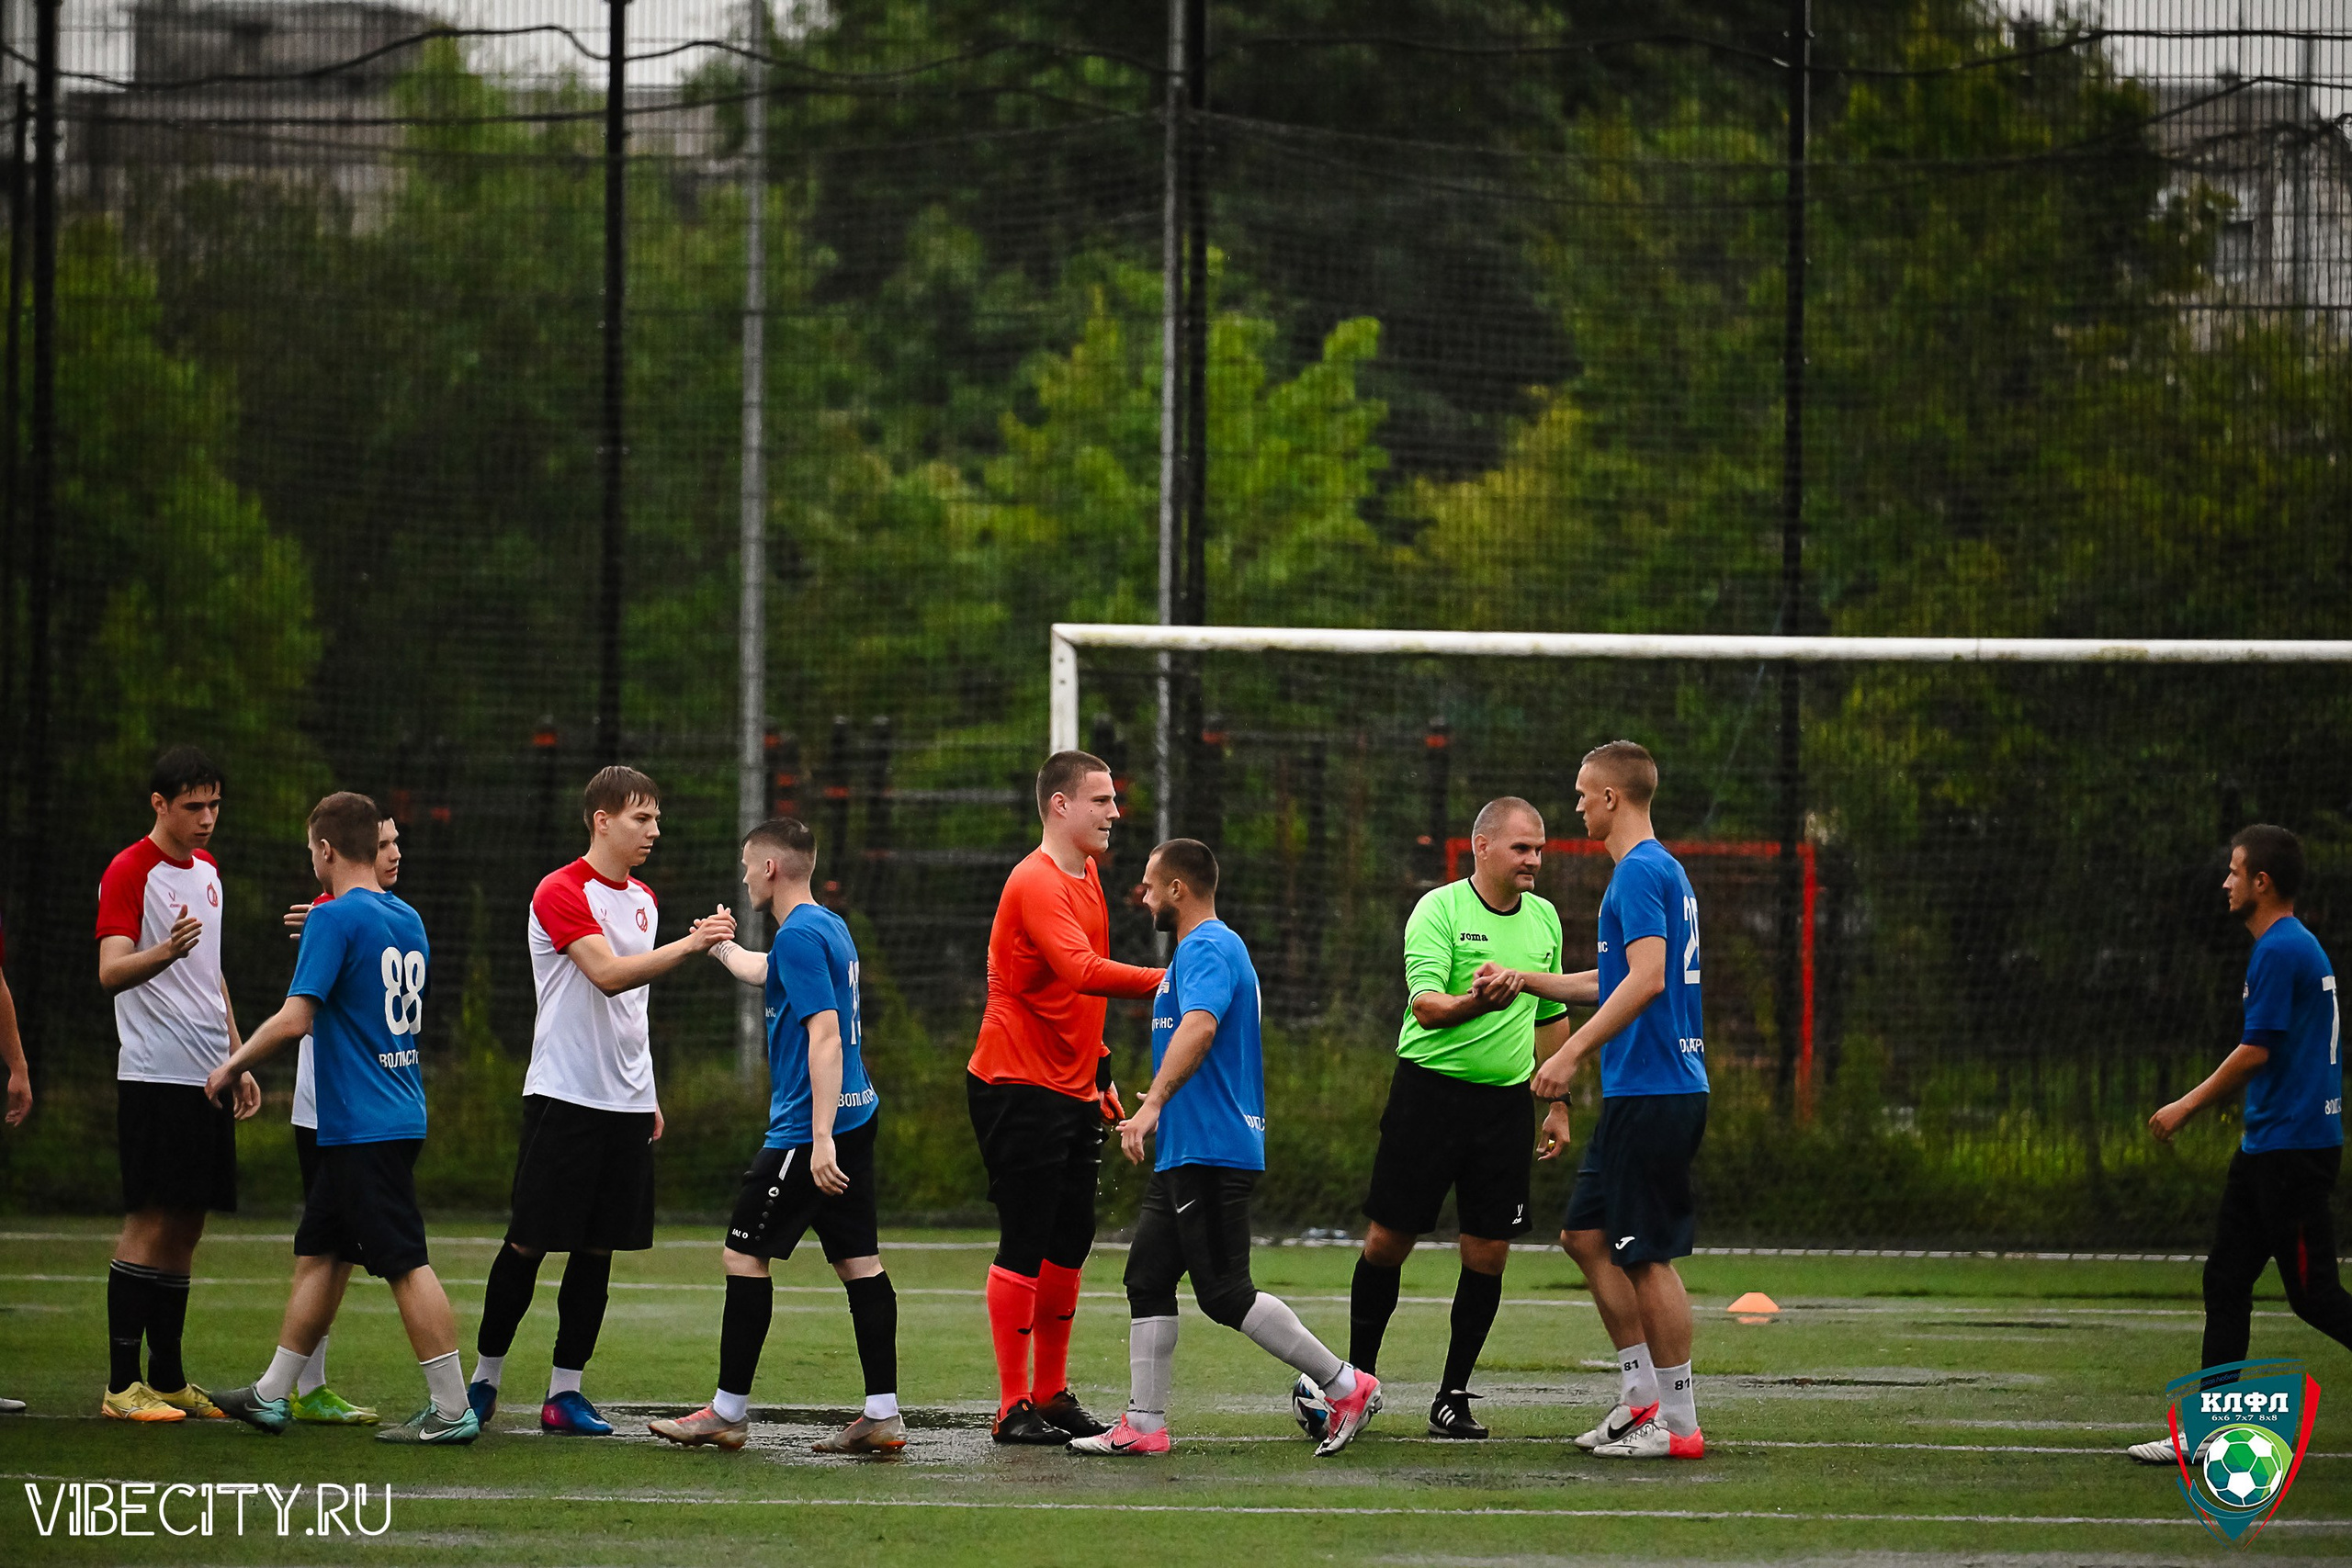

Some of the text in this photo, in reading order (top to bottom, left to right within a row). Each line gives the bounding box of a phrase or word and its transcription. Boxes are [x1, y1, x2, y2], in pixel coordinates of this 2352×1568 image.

[380, 946, 425, 1035] 88
[1623, 1359, 1639, 1371] 81
[1675, 1377, 1690, 1391] 81
